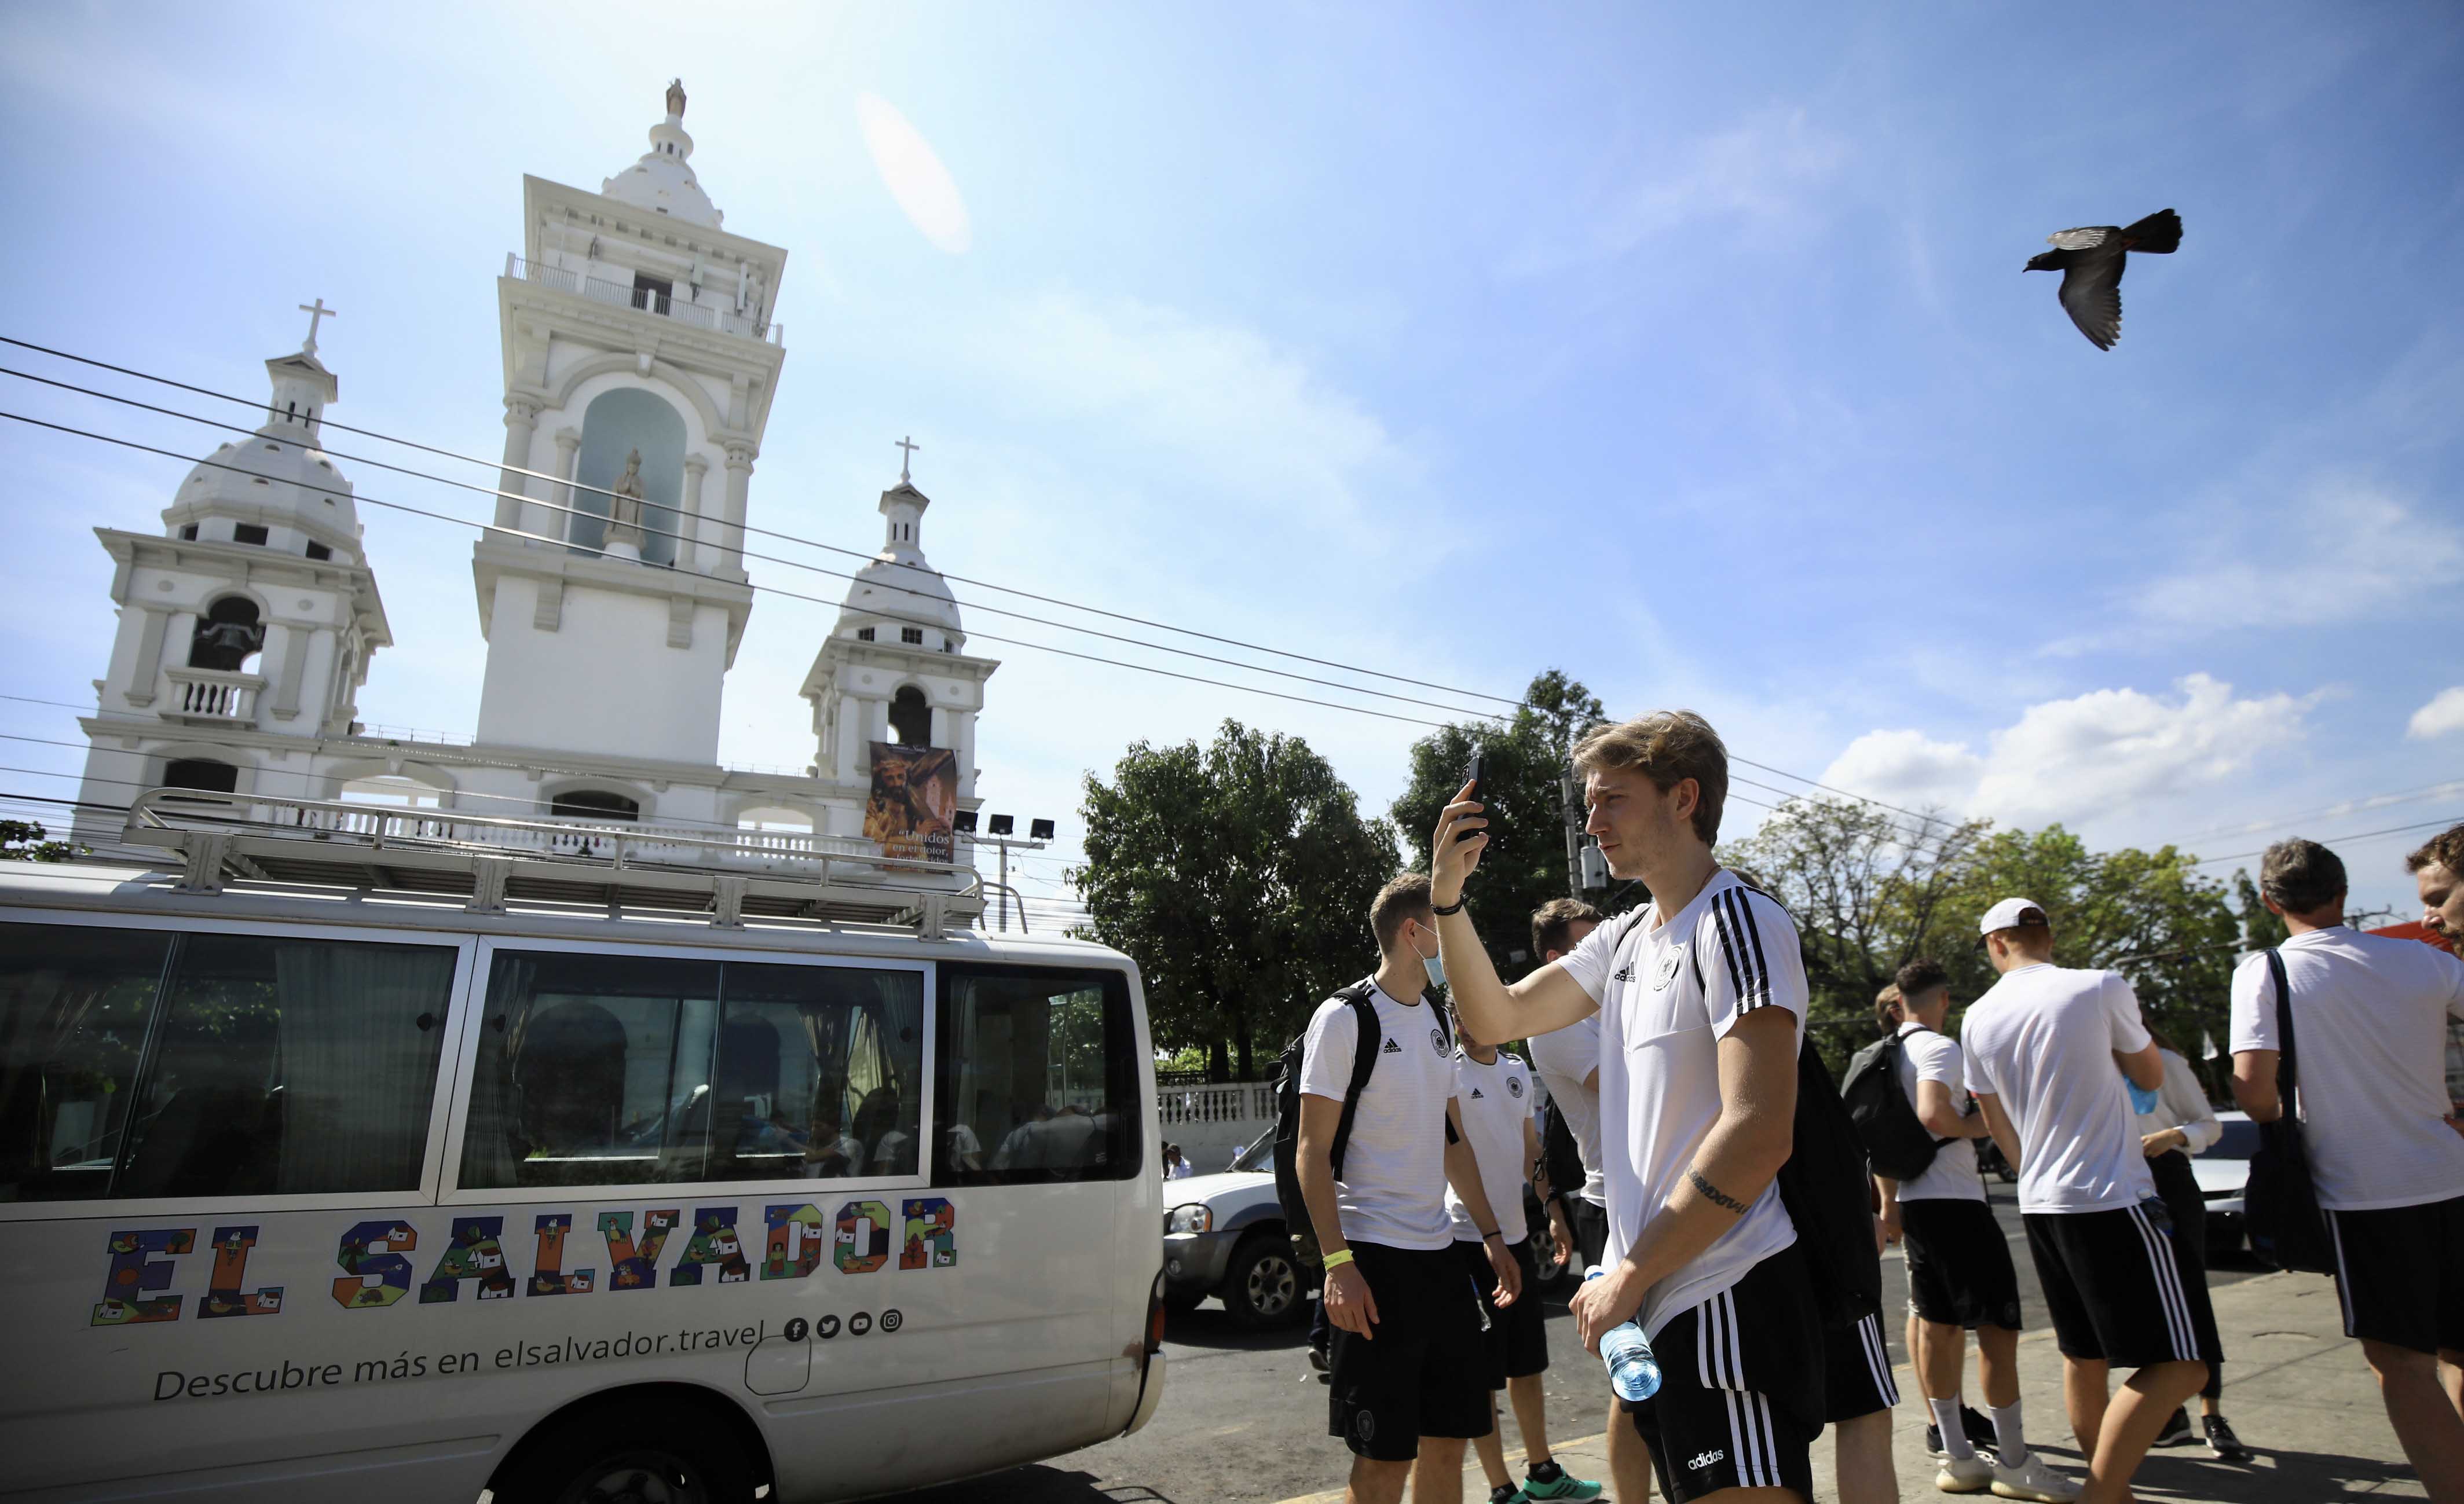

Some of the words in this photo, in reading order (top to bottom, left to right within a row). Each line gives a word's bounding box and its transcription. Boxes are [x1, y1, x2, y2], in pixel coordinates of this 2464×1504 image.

[920, 846, 949, 856] dolor,
[90, 1226, 284, 1326] EL
[331, 1197, 957, 1309] SALVADOR
[153, 1360, 343, 1400] Descubre
[354, 1351, 427, 1382] más
[438, 1352, 479, 1374] en
[494, 1320, 764, 1369] elsalvador.travel
[1688, 1450, 1723, 1470] adidas
